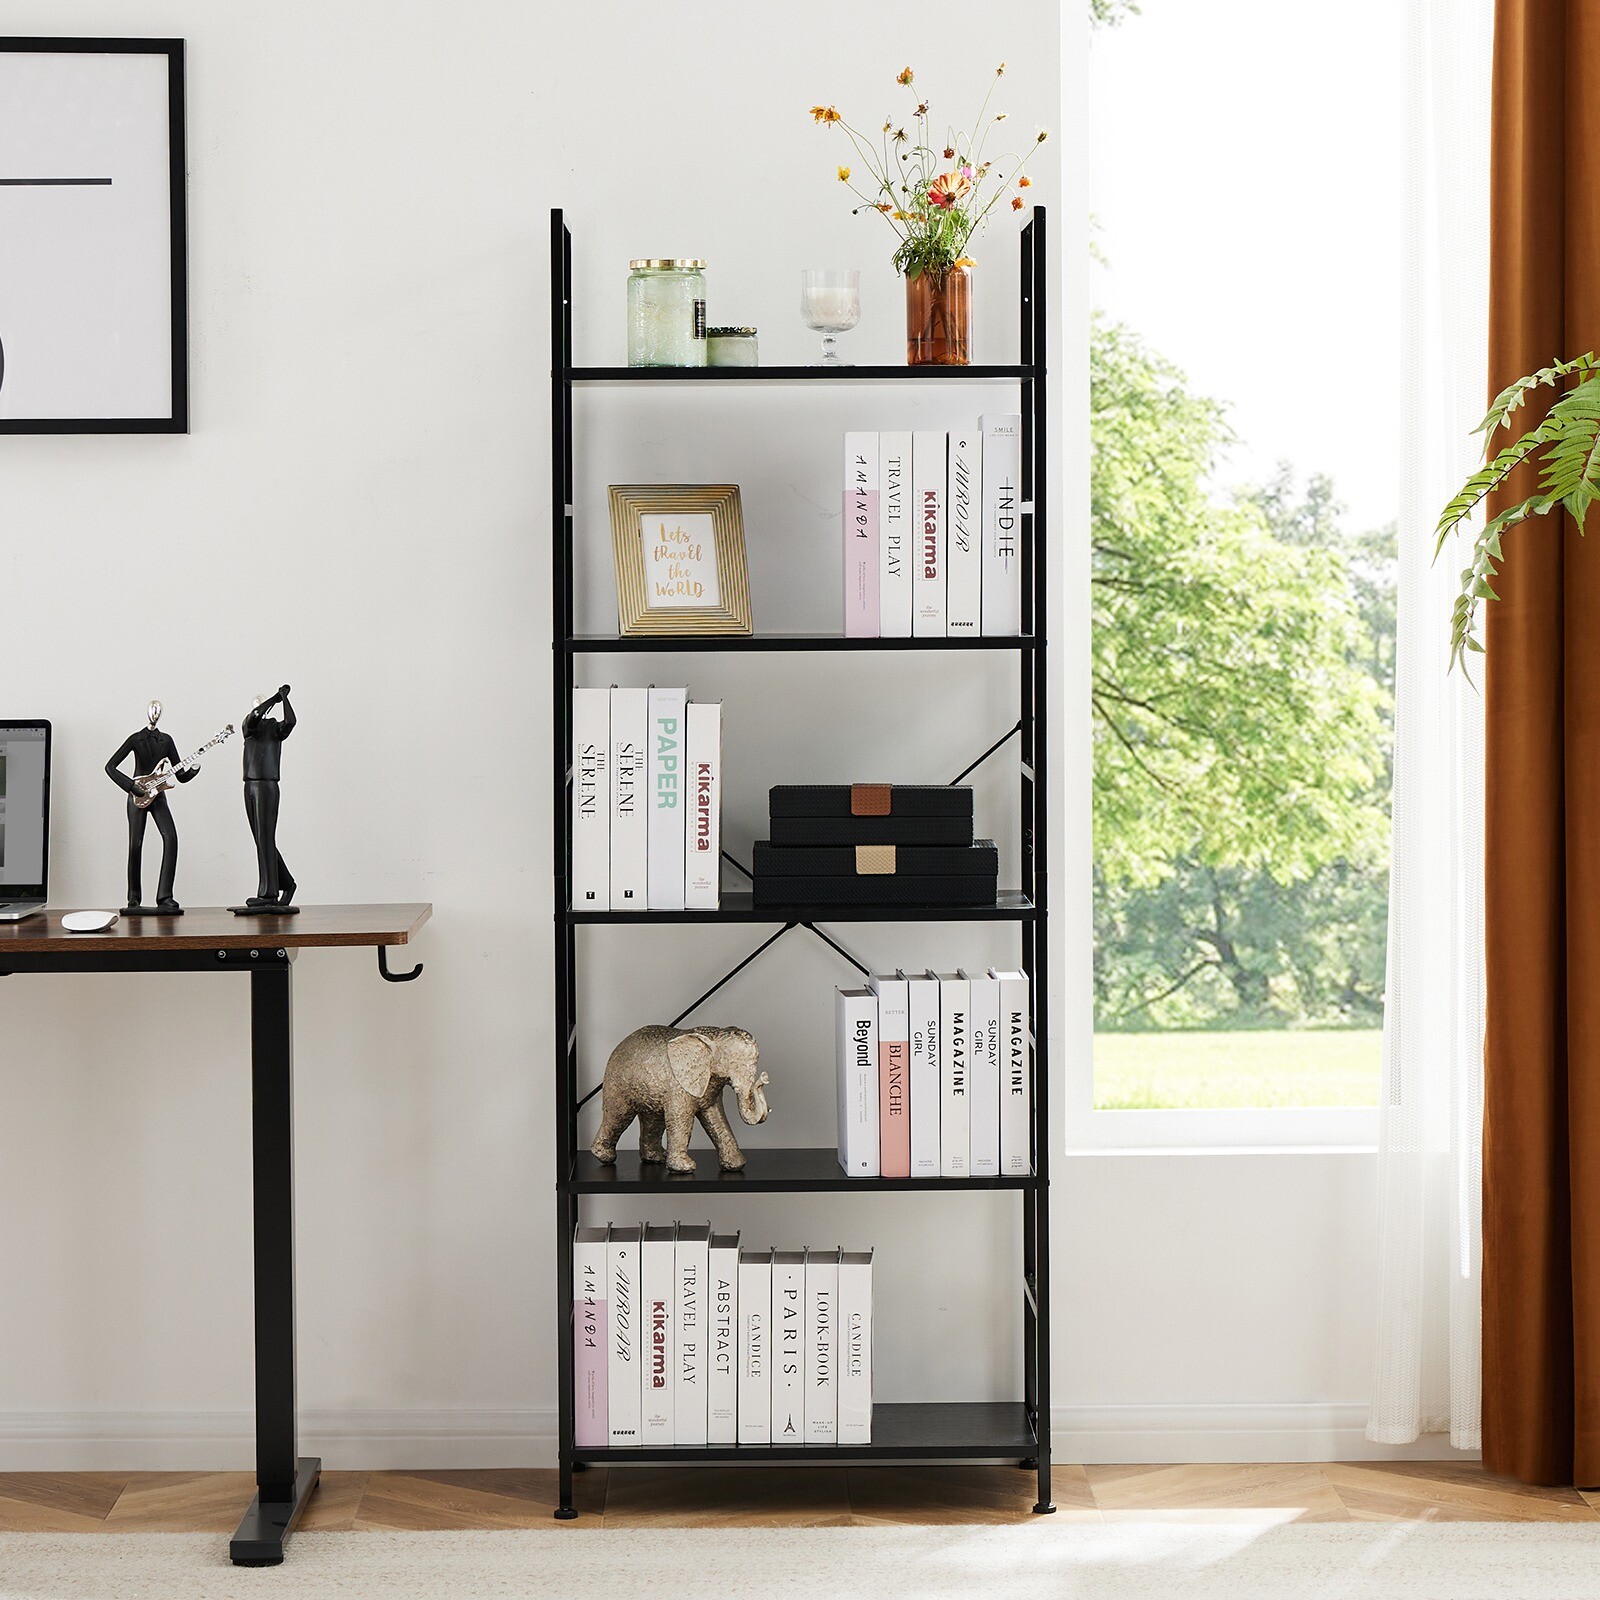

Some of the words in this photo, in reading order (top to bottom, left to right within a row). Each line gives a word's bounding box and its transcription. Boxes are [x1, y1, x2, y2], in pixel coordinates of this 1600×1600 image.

[855, 455, 868, 539] AMANDA
[888, 456, 901, 525] TRAVEL
[998, 487, 1014, 558] INDIE
[660, 523, 691, 543] Lets
[888, 535, 901, 578] PLAY
[924, 491, 940, 579] kikarma
[668, 562, 691, 580] the
[580, 743, 596, 819] SERENE
[596, 750, 605, 774] THE
[618, 742, 634, 818] SERENE
[634, 748, 643, 772] THE
[657, 718, 678, 810] PAPER
[697, 763, 715, 851] kikarma
[853, 1020, 872, 1067] Beyond
[914, 1031, 923, 1057] GIRL
[927, 1020, 936, 1067] SUNDAY
[953, 1012, 964, 1096] MAGAZINE
[974, 1030, 984, 1055] GIRL
[988, 1019, 997, 1066] SUNDAY
[1011, 1012, 1023, 1096] MAGAZINE
[889, 1044, 902, 1116] BLANCHE
[583, 1265, 597, 1348] AMANDA
[683, 1265, 696, 1331] TRAVEL
[717, 1280, 730, 1375] ABSTRACT
[652, 1301, 669, 1388] kikarma
[683, 1343, 696, 1384] PLAY
[750, 1314, 762, 1378] CANDICE
[816, 1291, 830, 1387] LOOK-BOOK
[850, 1313, 862, 1377] CANDICE
